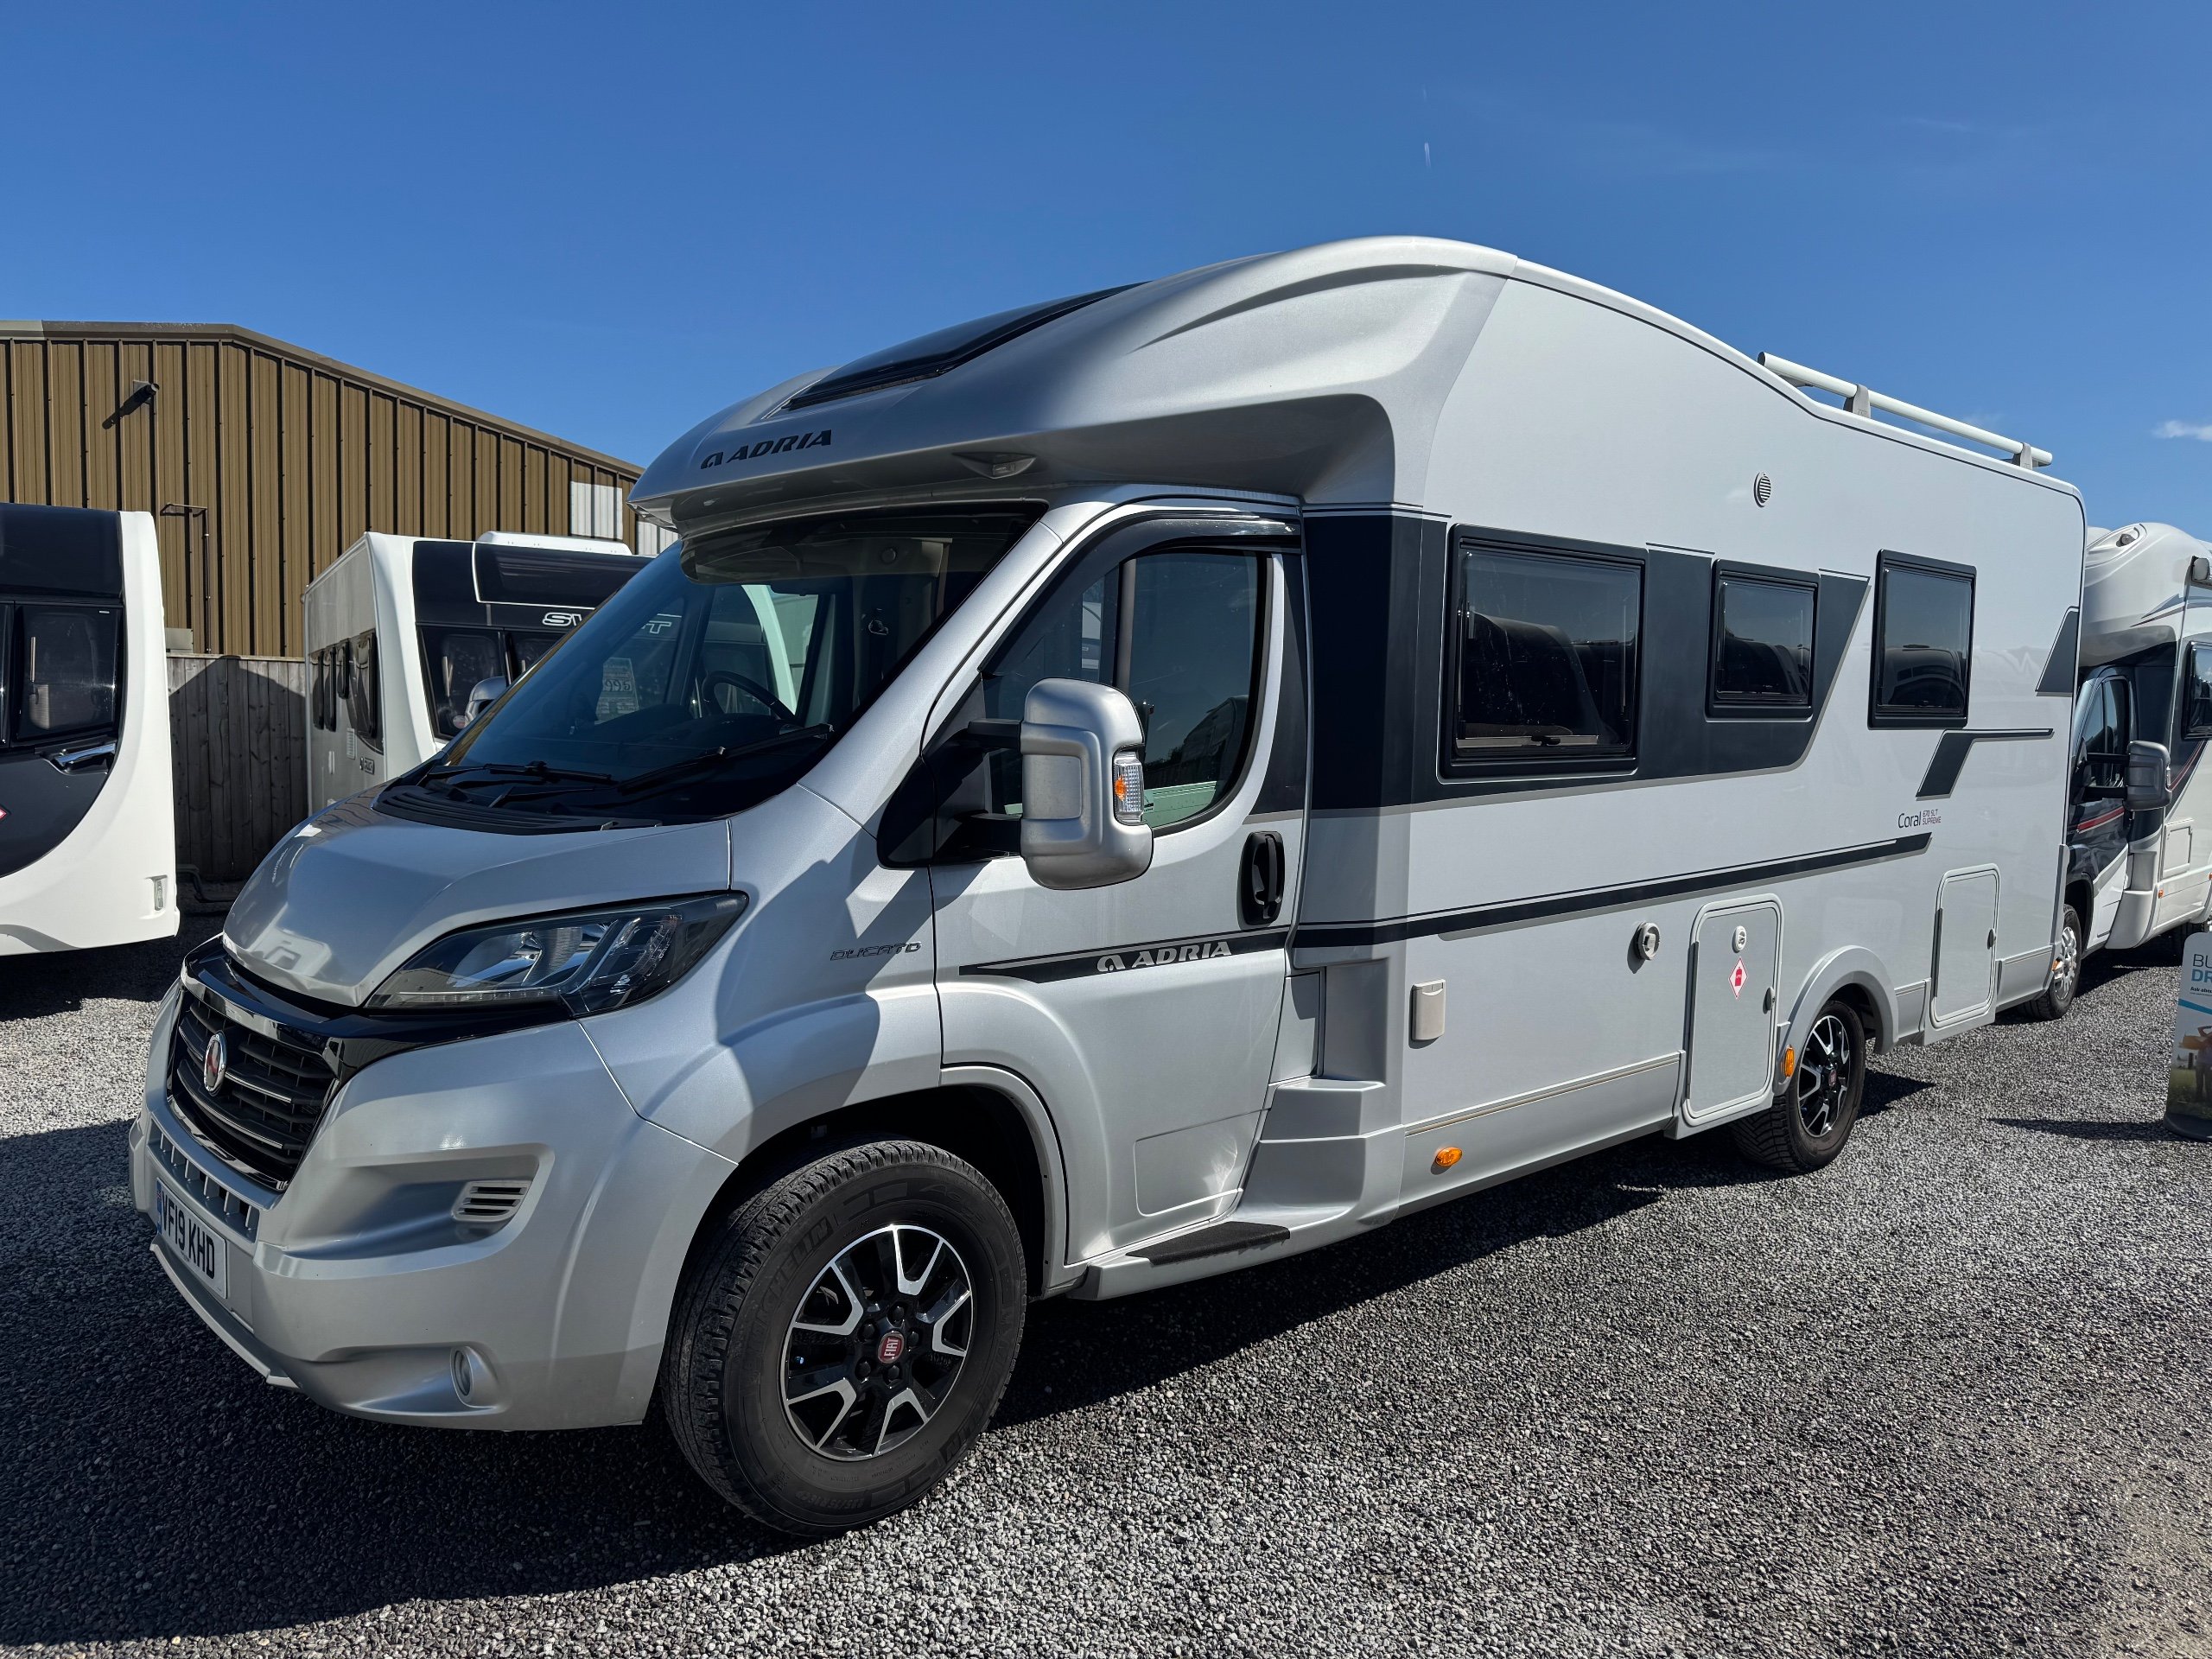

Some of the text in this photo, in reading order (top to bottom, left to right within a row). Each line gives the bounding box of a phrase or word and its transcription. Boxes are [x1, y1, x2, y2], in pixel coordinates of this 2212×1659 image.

[726, 429, 832, 464] ADRIA
[1897, 810, 1922, 829] Coral
[830, 942, 922, 961] DUCATO
[1131, 941, 1232, 969] ADRIA
[162, 1191, 215, 1280] VF19 KHD
[883, 1338, 899, 1357] FIAT
